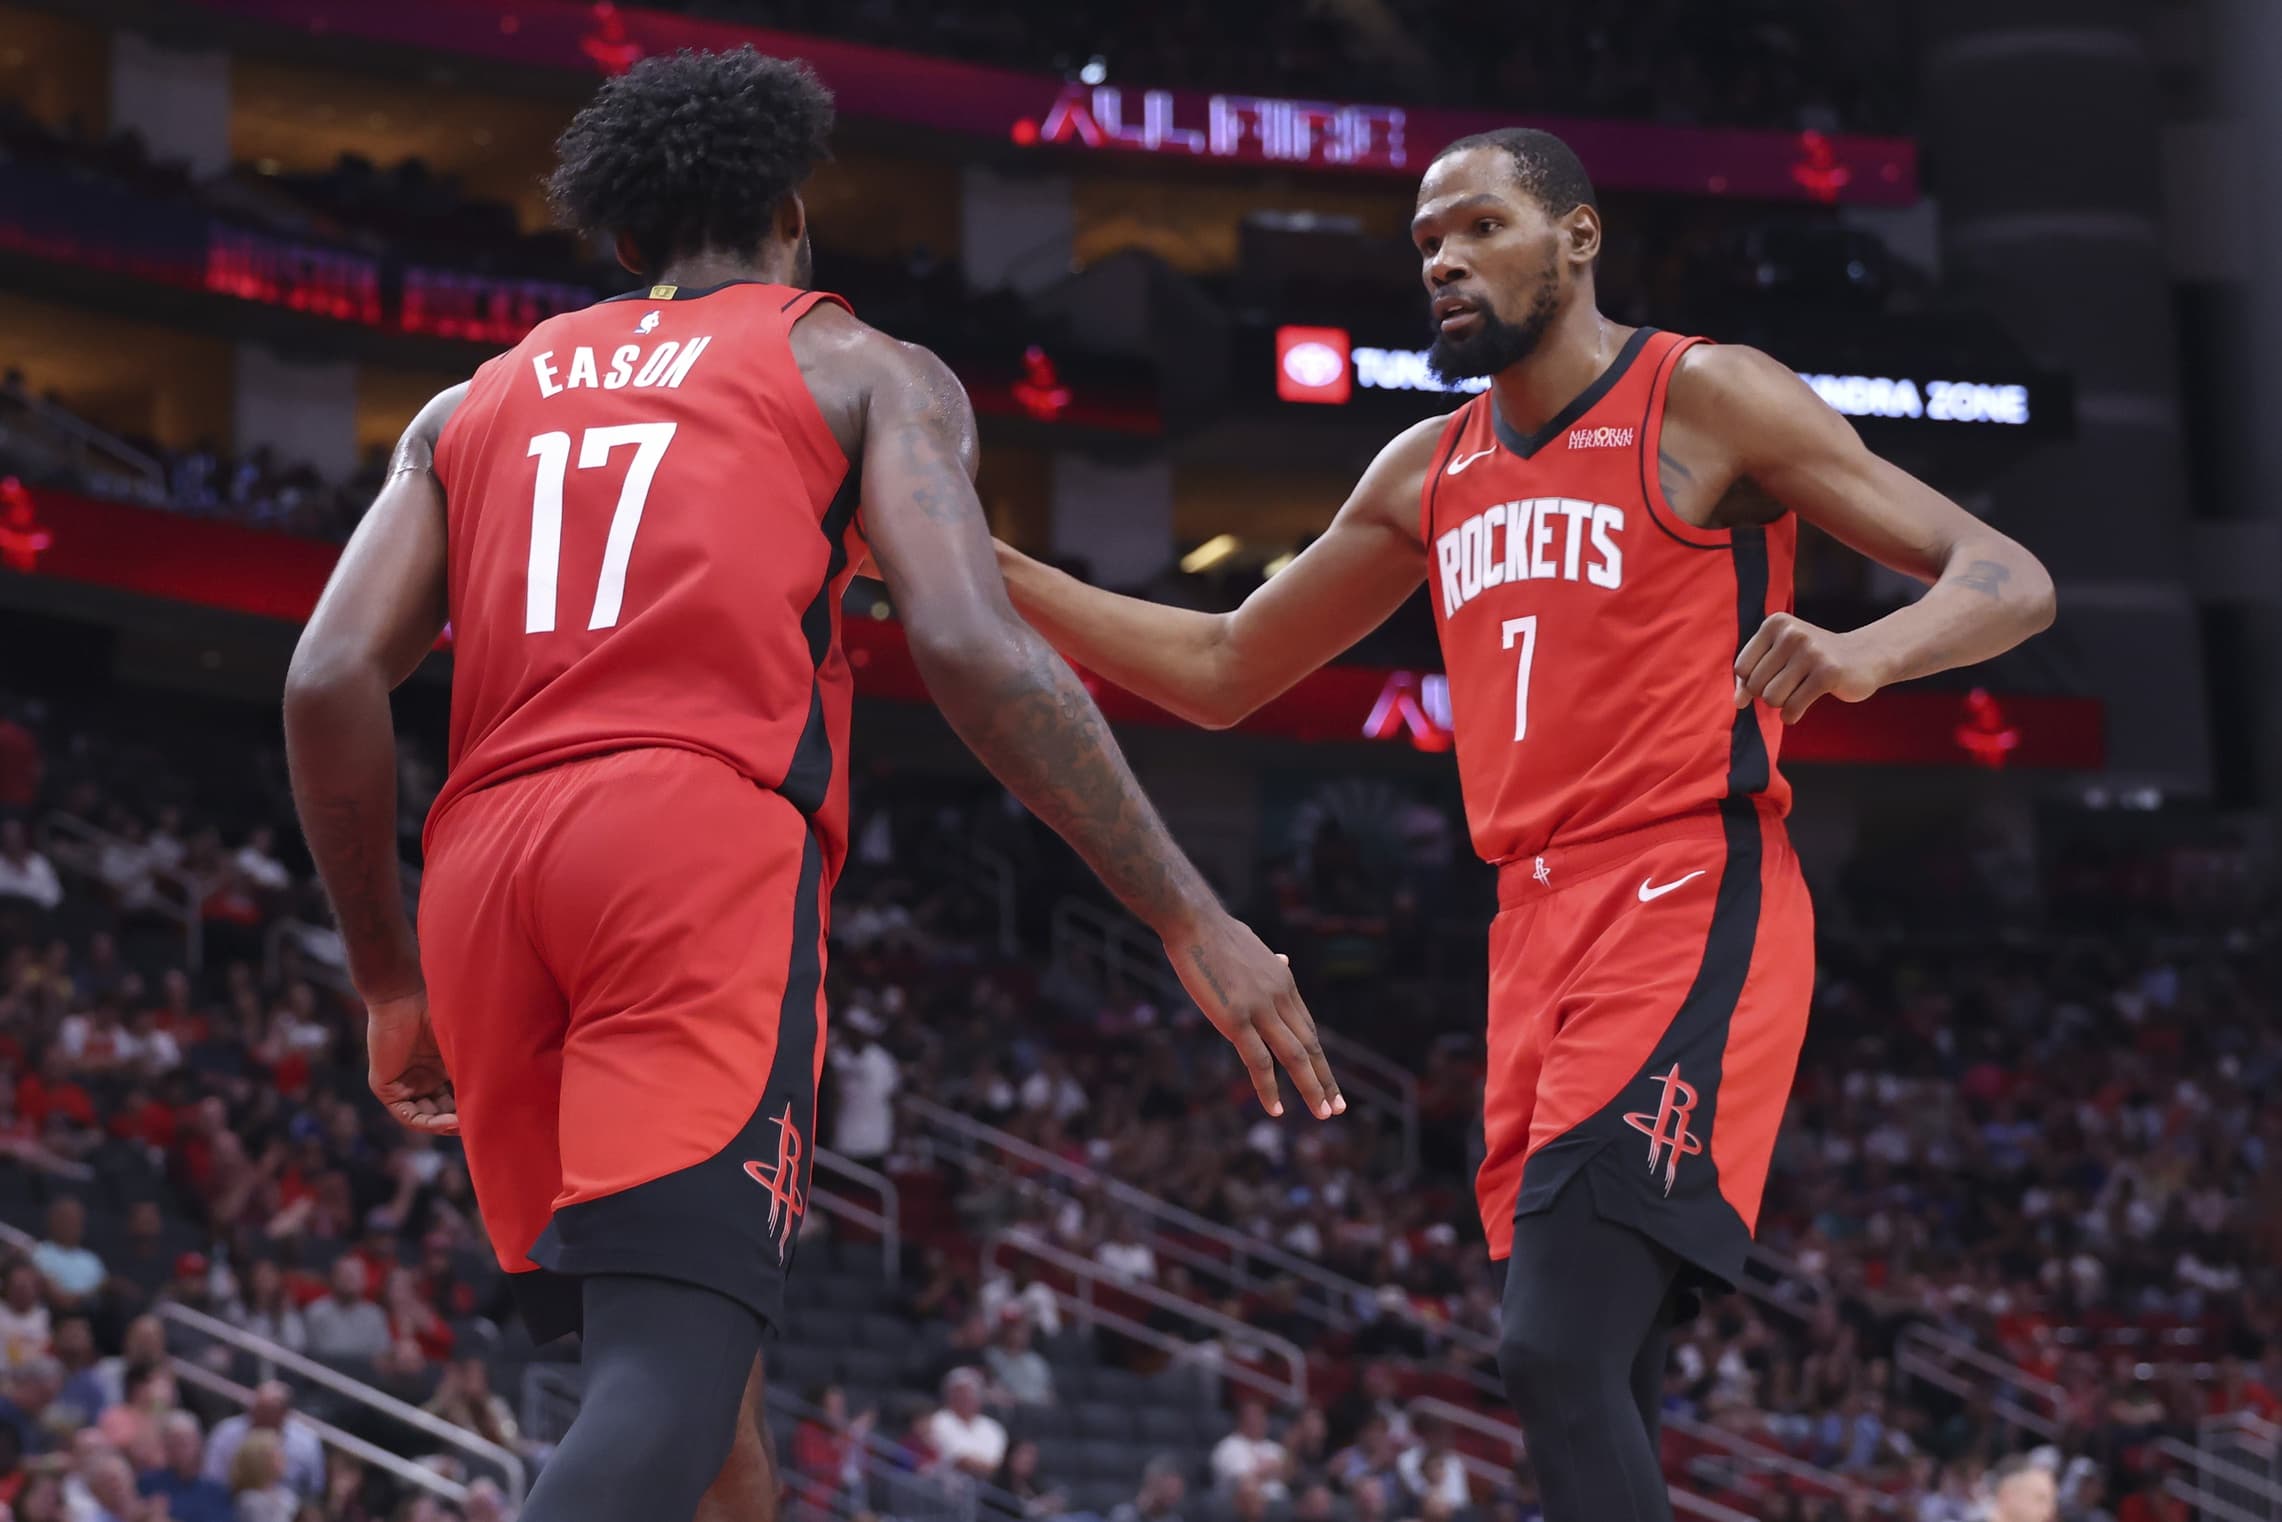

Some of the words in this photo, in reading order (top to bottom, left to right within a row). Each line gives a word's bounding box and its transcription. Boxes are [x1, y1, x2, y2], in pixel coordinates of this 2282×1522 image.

[532, 336, 712, 399] EASON
[1569, 426, 1633, 441] MEMORIAL
[1925, 380, 2029, 424] ZONE
[1568, 436, 1632, 449] HERMANN
[525, 422, 677, 634] 17
[1436, 497, 1625, 620] ROCKETS
[1501, 615, 1537, 742] 7
